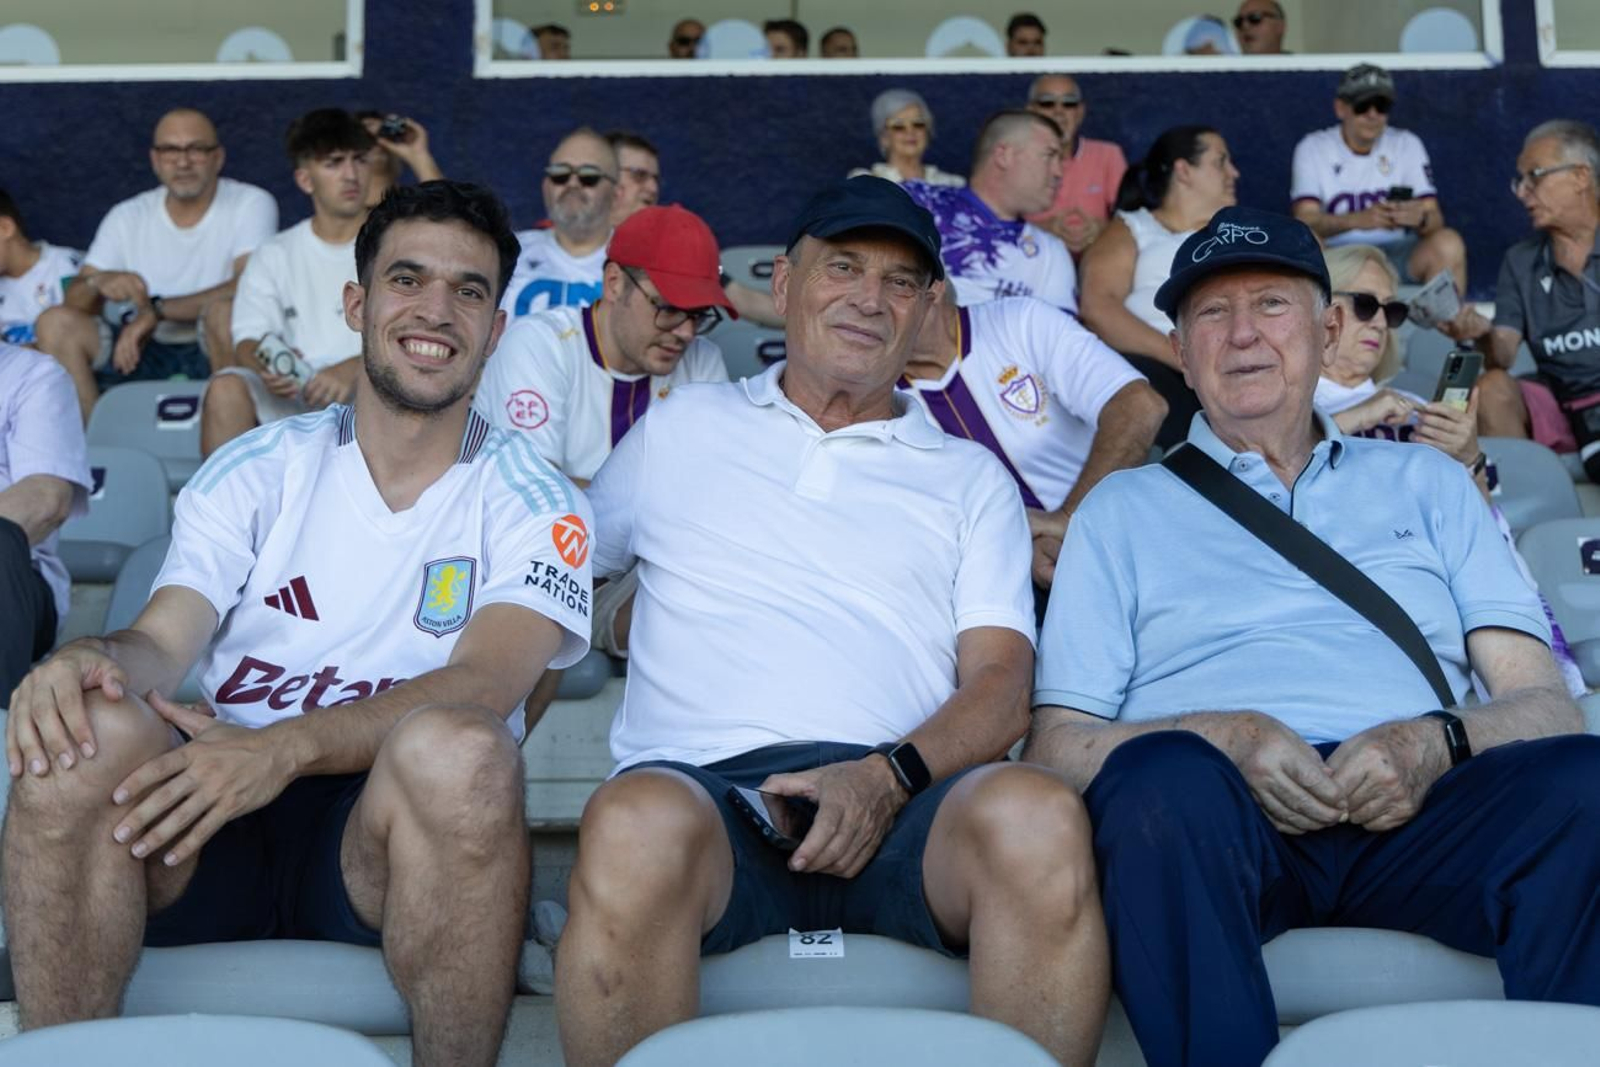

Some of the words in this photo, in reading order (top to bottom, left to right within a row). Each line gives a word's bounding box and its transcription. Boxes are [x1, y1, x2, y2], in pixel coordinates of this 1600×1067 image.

[524, 575, 588, 617] NATION
[530, 560, 589, 604] TRADE
[215, 655, 408, 712] Beta
